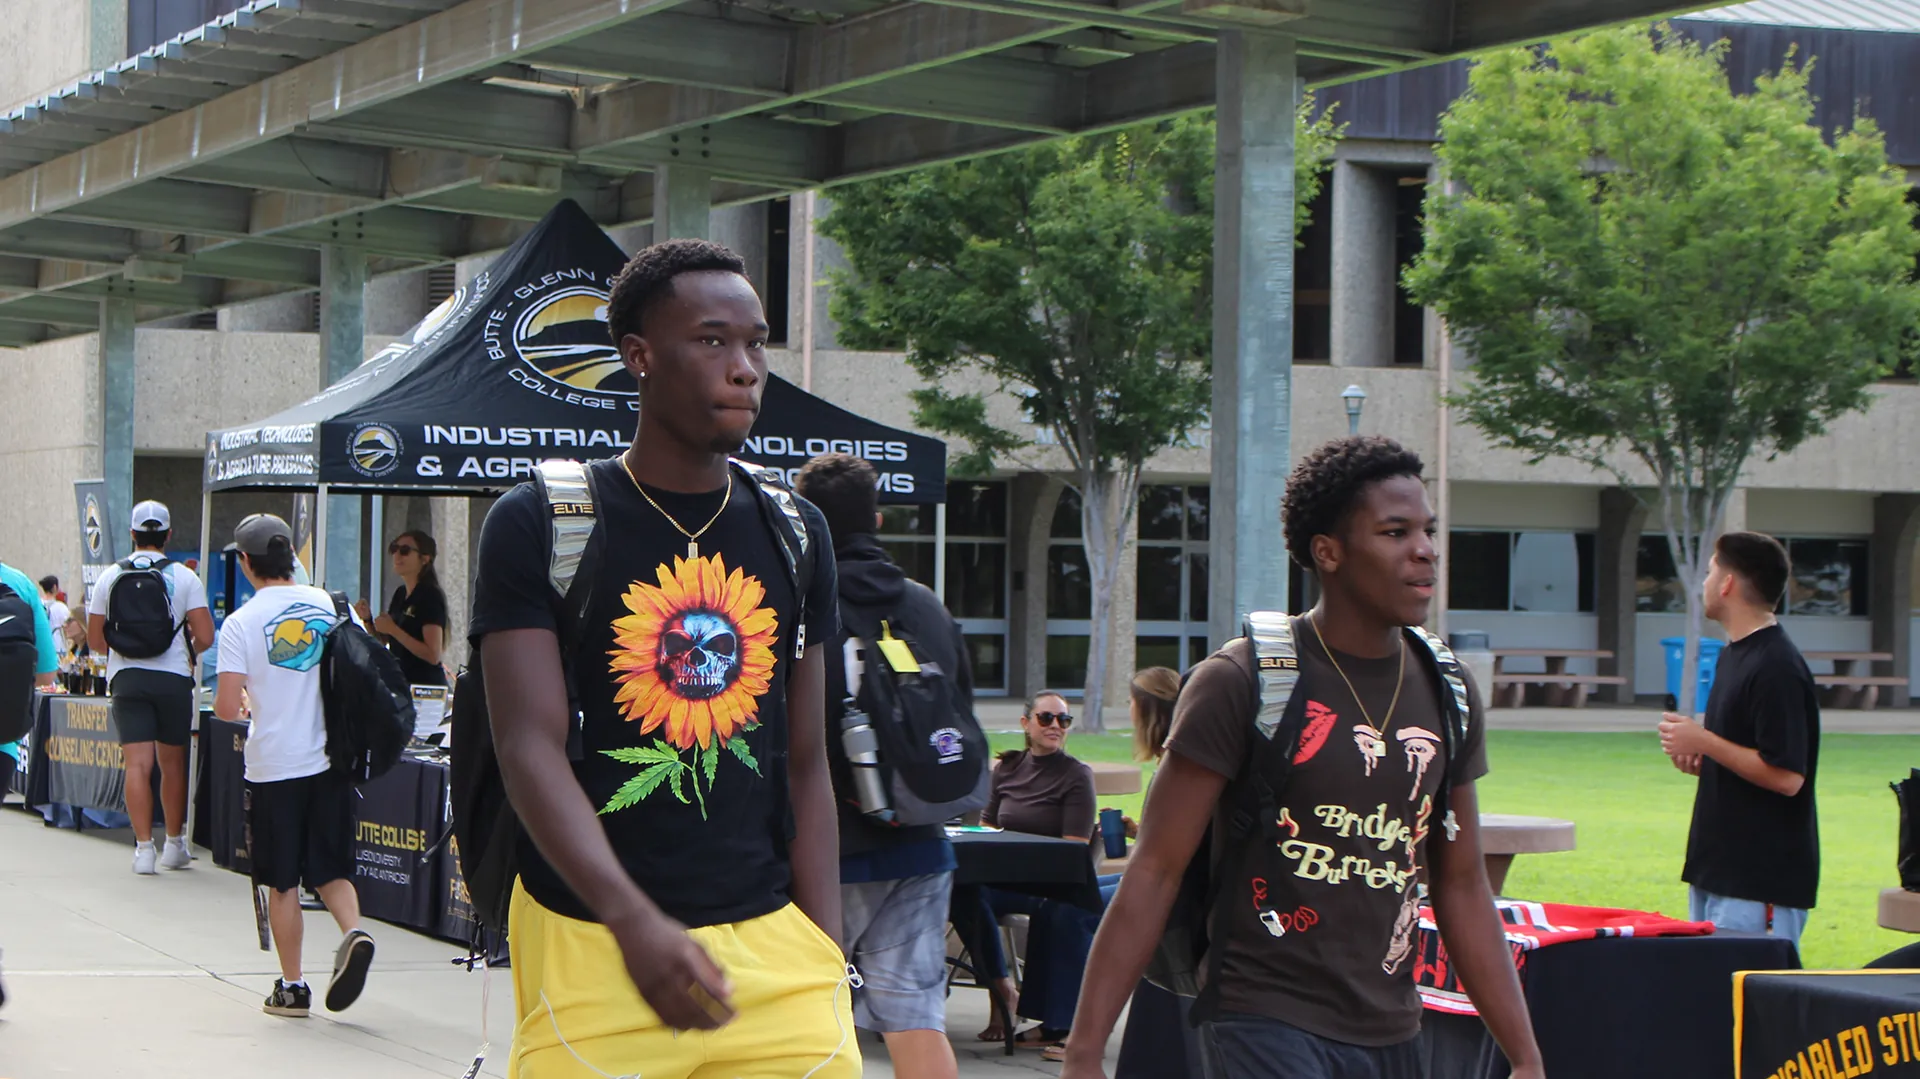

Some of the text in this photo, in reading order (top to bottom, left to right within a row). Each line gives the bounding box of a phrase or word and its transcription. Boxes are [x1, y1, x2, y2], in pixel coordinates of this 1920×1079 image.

[484, 309, 508, 361] BUTTE
[514, 267, 596, 300] GLENN
[508, 368, 616, 410] COLLEGE
[423, 424, 908, 462] INDUSTRIAL NOLOGIES
[416, 455, 443, 477] &
[66, 702, 108, 732] TRANSFER
[355, 820, 381, 846] UTTE
